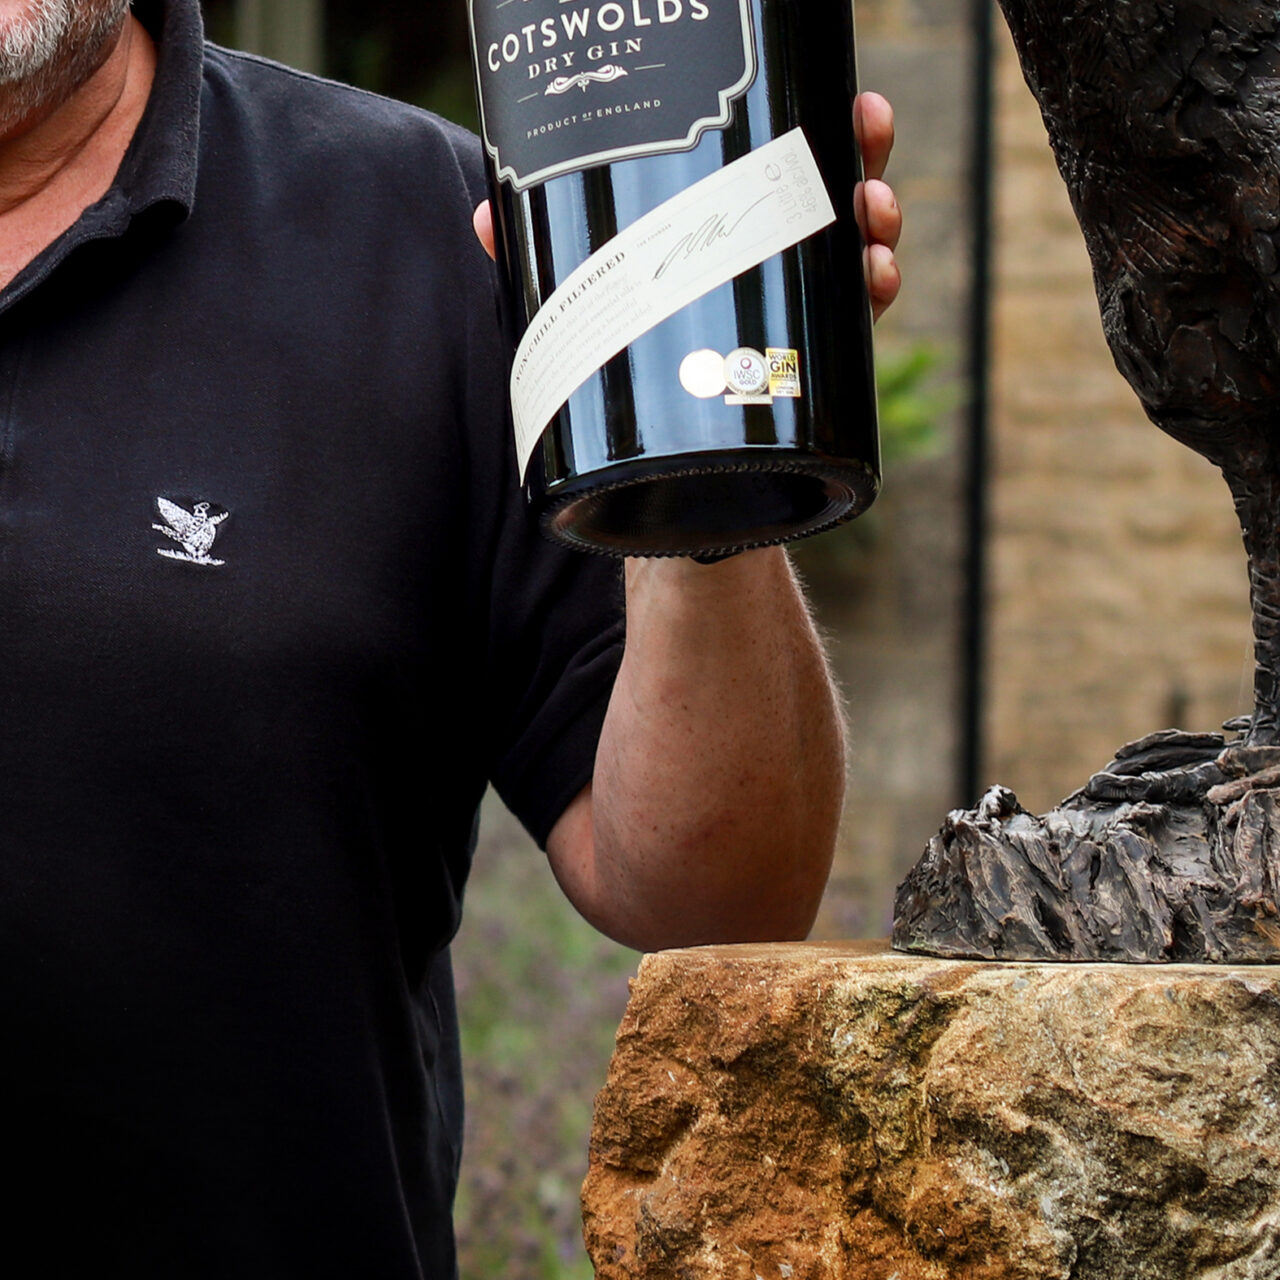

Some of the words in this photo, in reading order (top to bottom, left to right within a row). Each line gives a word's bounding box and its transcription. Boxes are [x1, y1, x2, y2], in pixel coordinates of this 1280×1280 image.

[527, 51, 576, 79] DRY
[586, 37, 643, 60] GIN
[526, 114, 577, 139] PRODUCT
[596, 99, 662, 118] ENGLAND
[558, 250, 627, 314] FILTERED
[733, 370, 760, 380] IWSC
[770, 360, 796, 373] GIN
